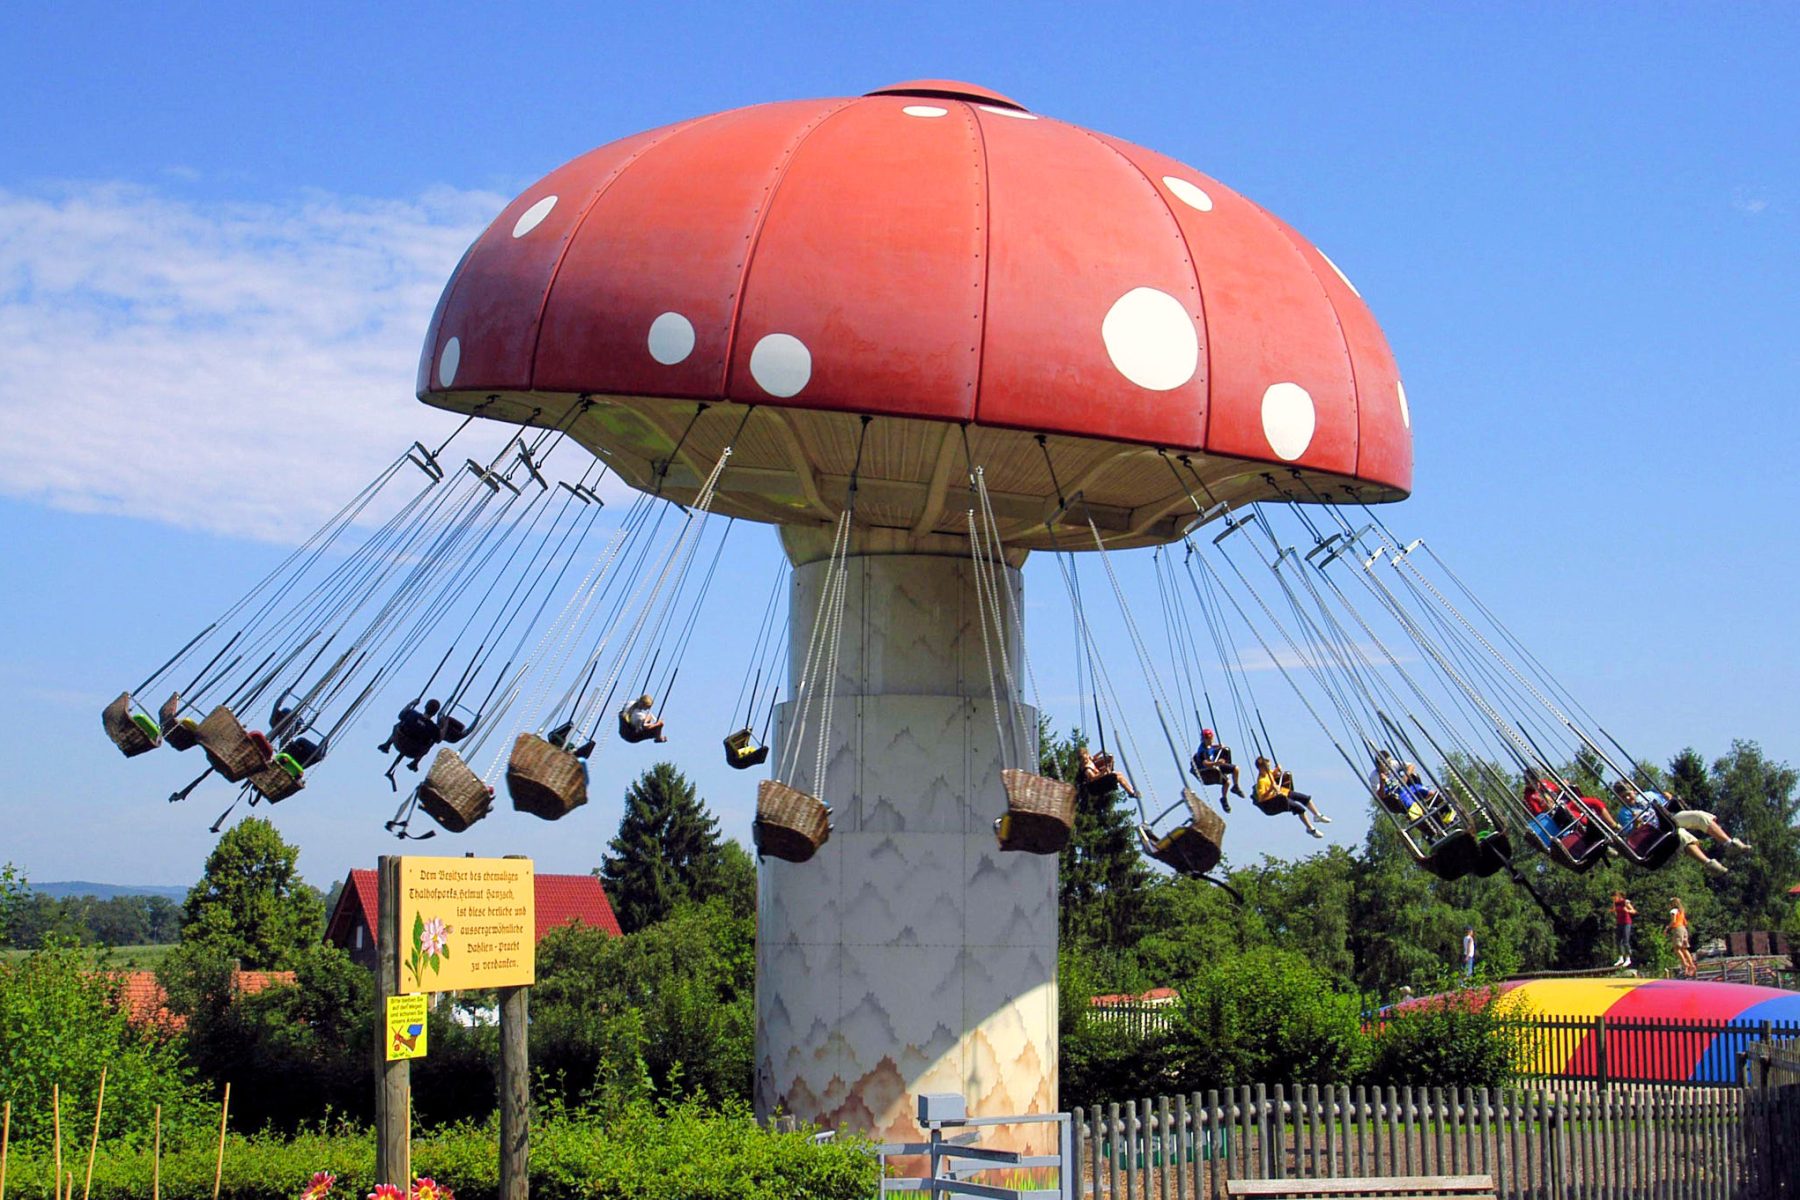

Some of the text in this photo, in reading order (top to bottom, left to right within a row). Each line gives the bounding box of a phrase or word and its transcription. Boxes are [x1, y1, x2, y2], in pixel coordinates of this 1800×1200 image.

[420, 870, 518, 883] Dem Besitzer des ehemaligen
[457, 906, 466, 917] ist
[468, 906, 486, 917] diese
[514, 906, 527, 916] und
[471, 962, 480, 972] zu
